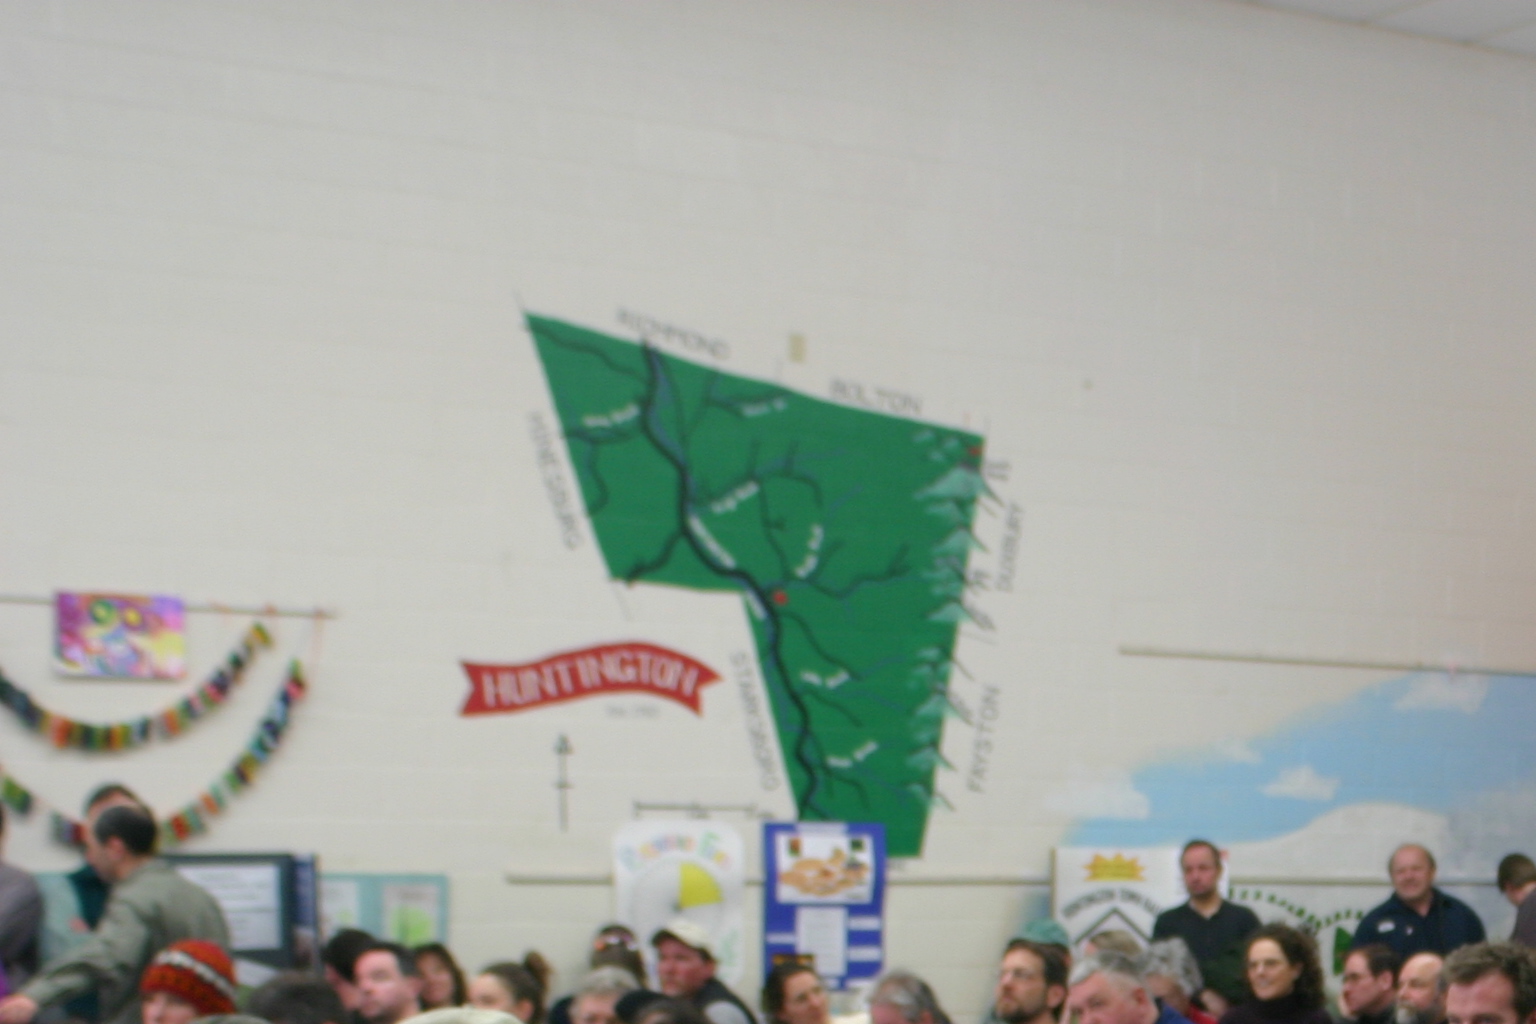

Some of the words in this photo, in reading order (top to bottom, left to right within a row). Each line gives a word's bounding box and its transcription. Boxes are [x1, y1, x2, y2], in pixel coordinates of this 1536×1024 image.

[829, 377, 922, 415] BOLTON
[480, 649, 700, 708] HUNTINGTON
[967, 683, 1001, 793] FAYSTON
